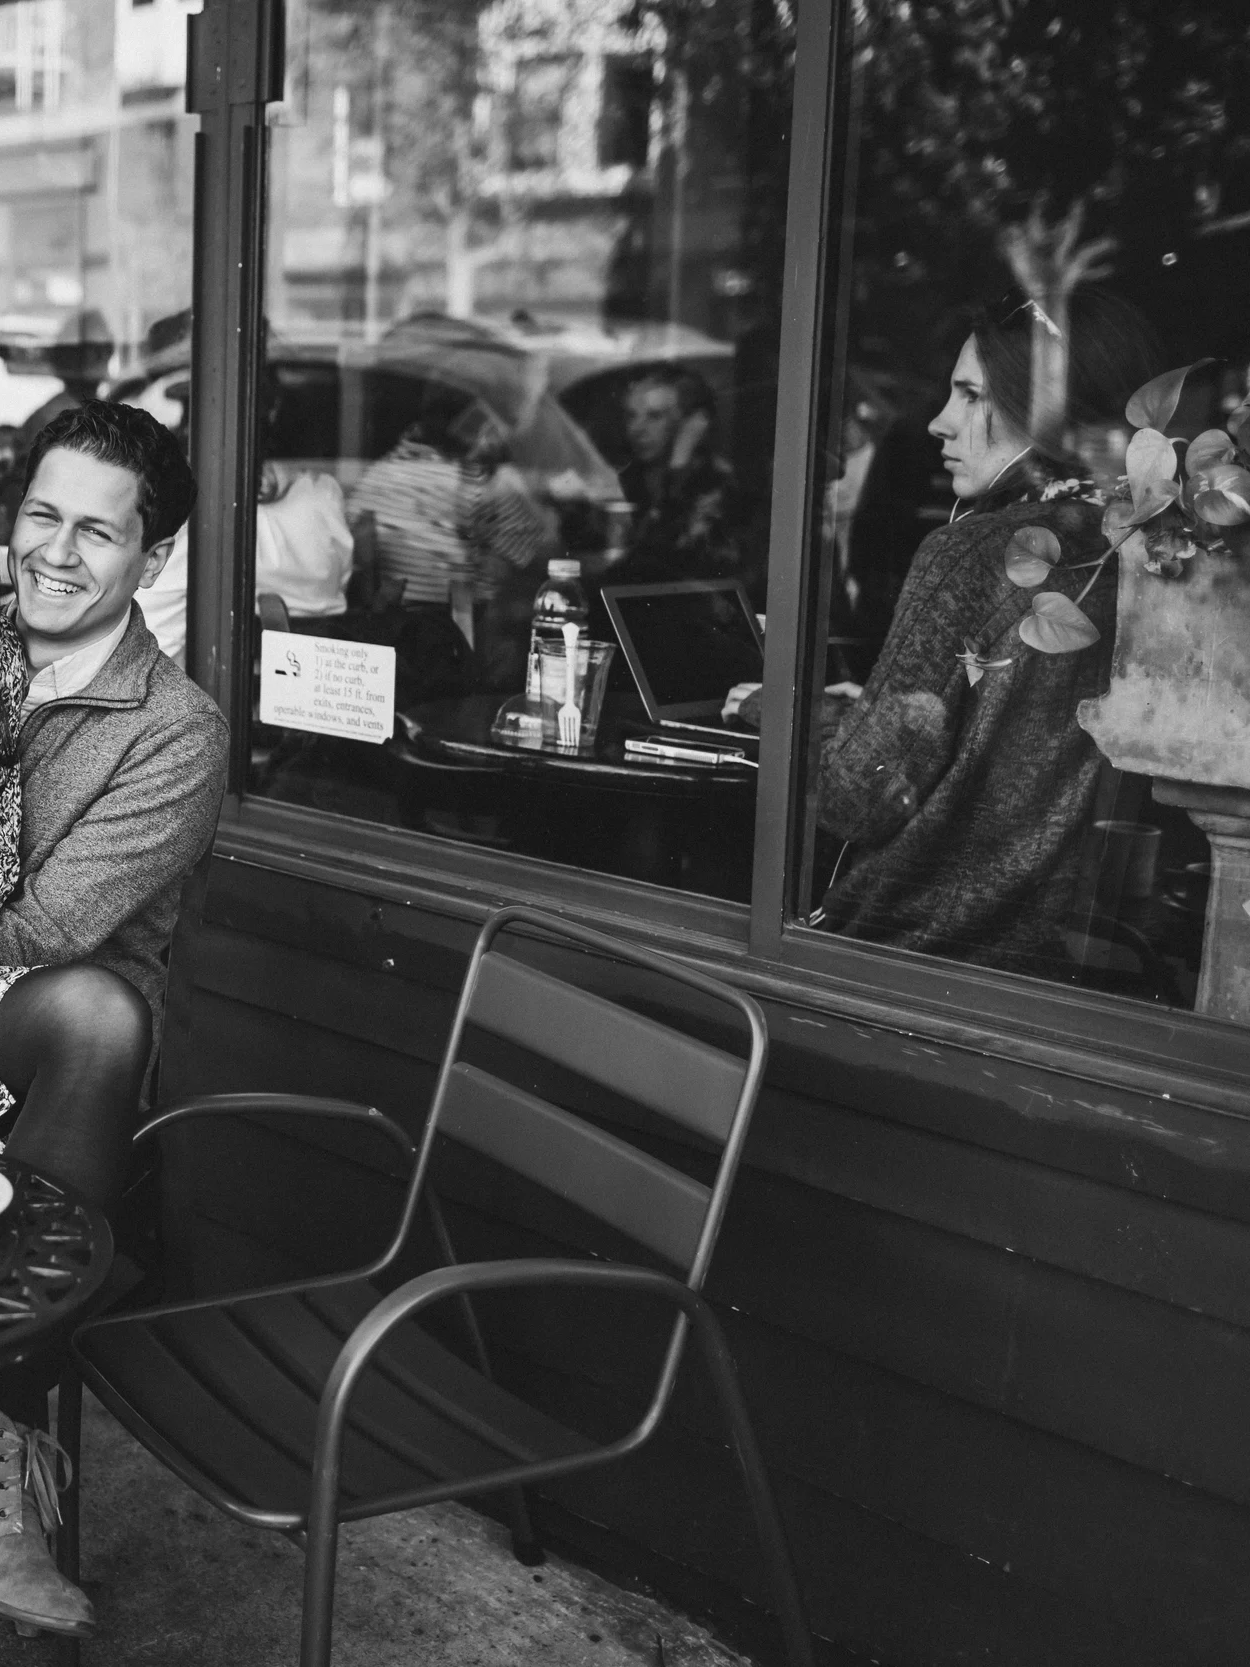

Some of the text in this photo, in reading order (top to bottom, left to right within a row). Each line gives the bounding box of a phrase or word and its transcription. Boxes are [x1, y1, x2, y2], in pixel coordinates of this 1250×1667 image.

[315, 643, 368, 661] Smoking only
[316, 656, 379, 674] 1) at the curb, or
[315, 669, 364, 687] 2) if no curb,
[314, 683, 385, 703] at least 15 ft. from
[336, 700, 375, 716] entrances,
[274, 704, 306, 717] operable
[308, 708, 344, 725] windows,
[346, 716, 361, 727] and
[363, 719, 383, 731] vents
